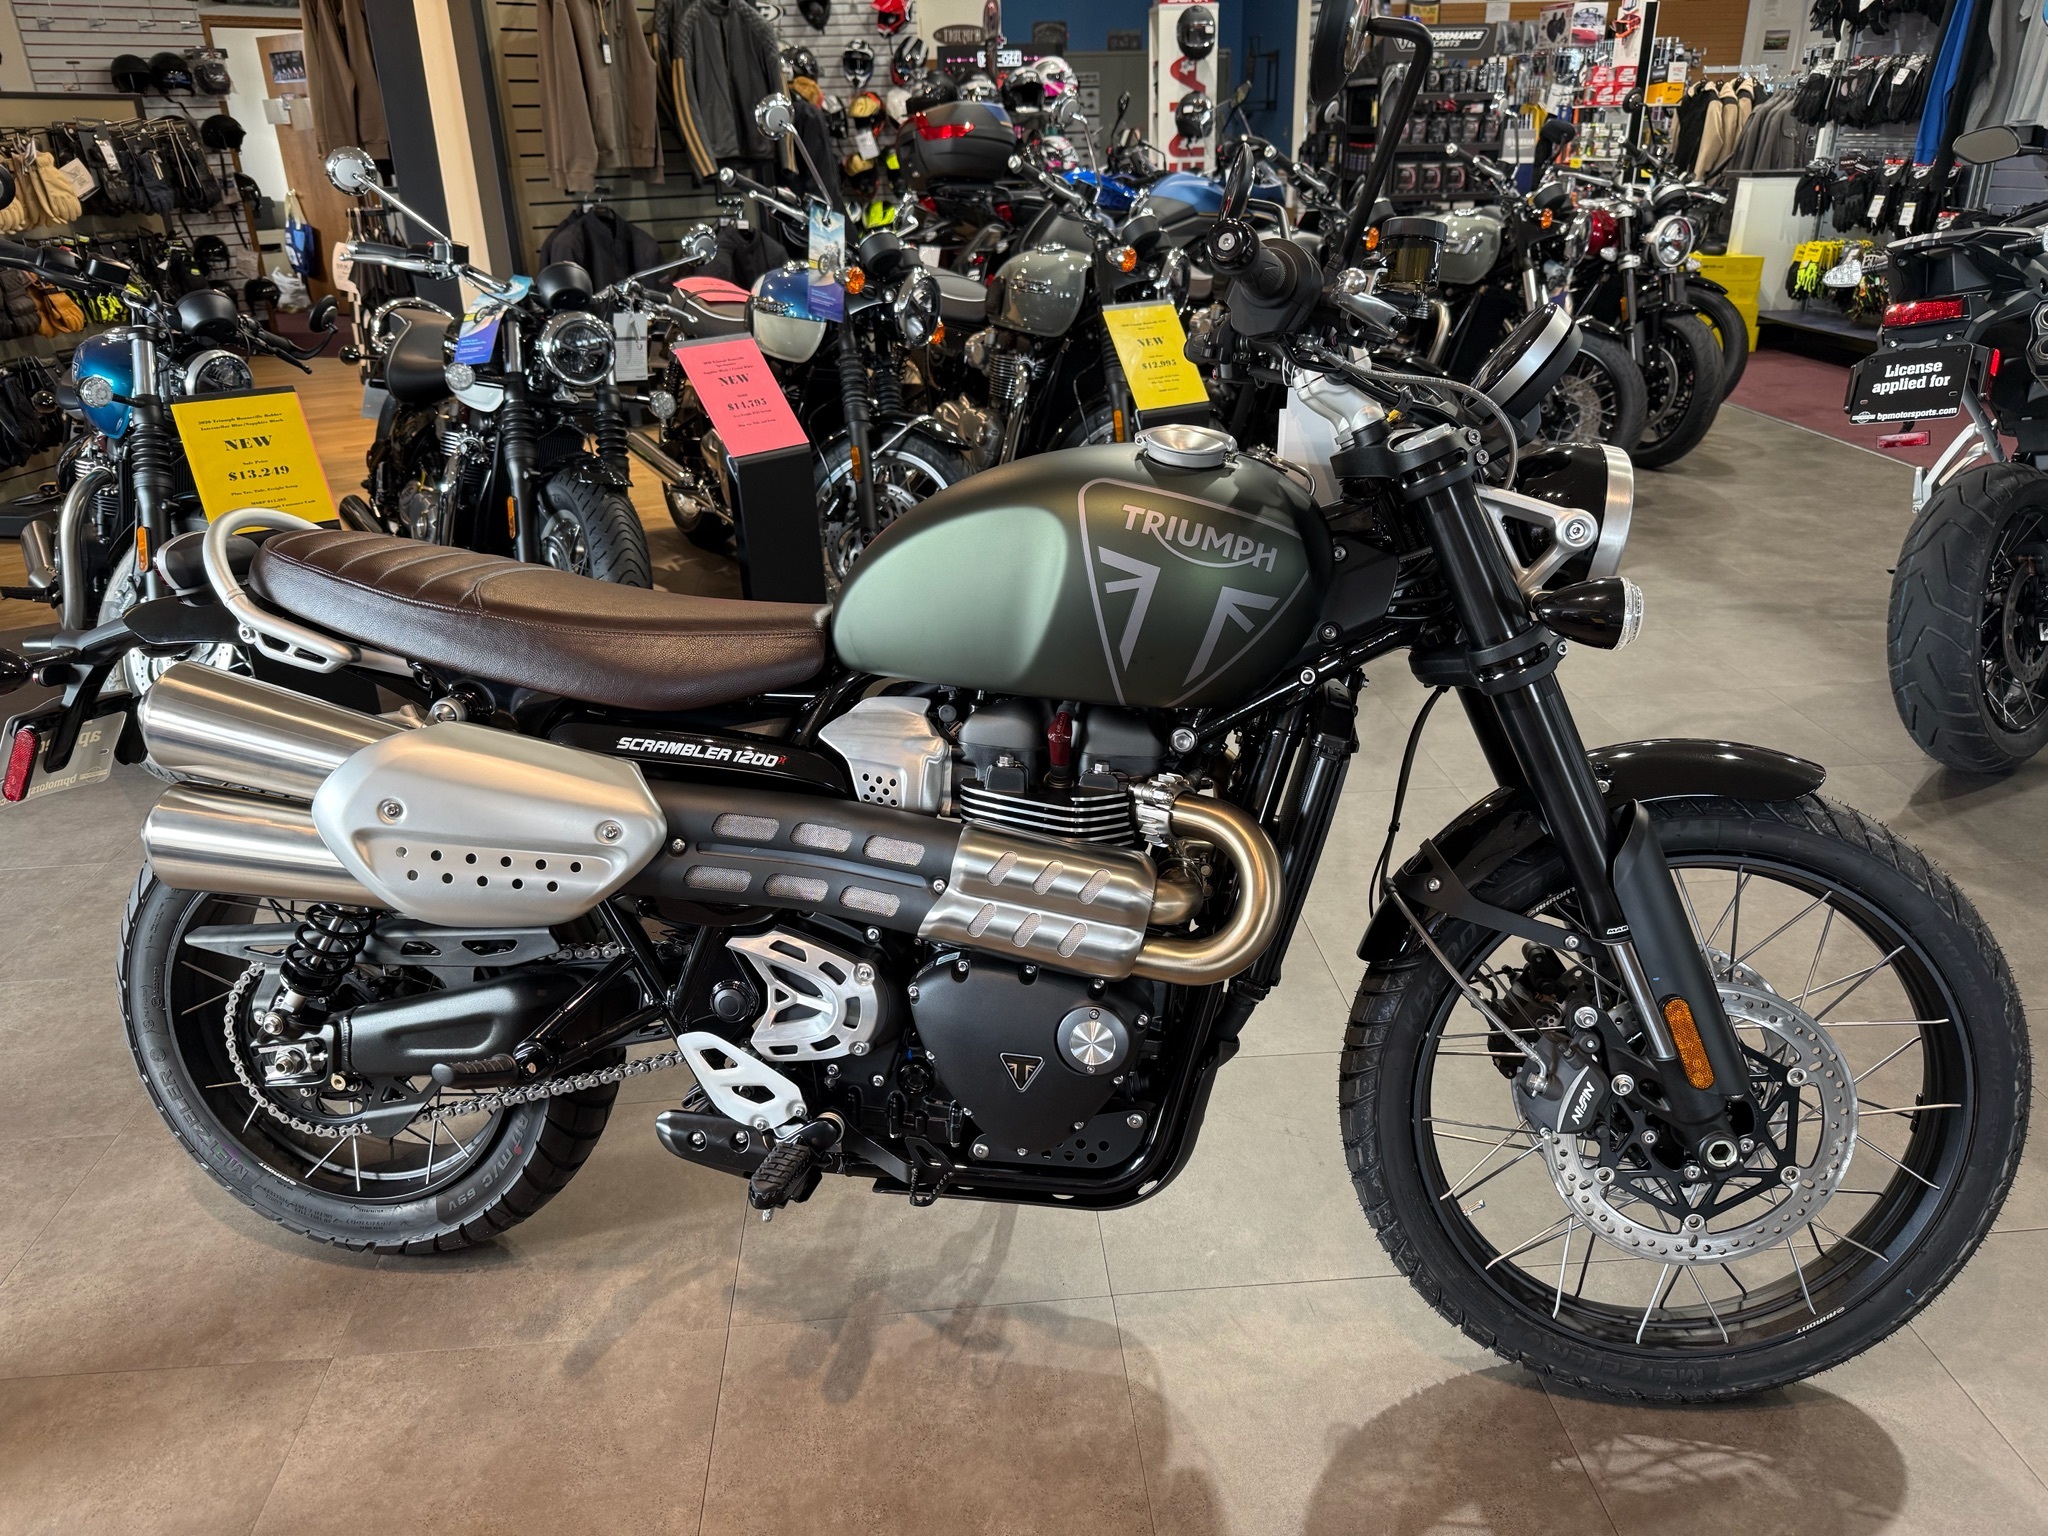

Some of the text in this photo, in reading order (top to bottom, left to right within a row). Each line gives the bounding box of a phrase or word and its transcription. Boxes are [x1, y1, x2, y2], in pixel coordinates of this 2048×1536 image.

[1137, 336, 1164, 348] NEW
[718, 372, 749, 386] NEW
[1884, 361, 1943, 378] License
[1872, 374, 1951, 395] applied for
[1876, 407, 1958, 421] bpmotorsports.com
[223, 434, 273, 451] NEW
[228, 465, 290, 482] $13,249
[1122, 504, 1278, 573] TRIUMPH
[616, 736, 732, 762] SCRAMBLER
[1571, 1081, 1596, 1125] NISSIN
[158, 1067, 249, 1182] METZELER
[448, 1187, 476, 1212] 69V
